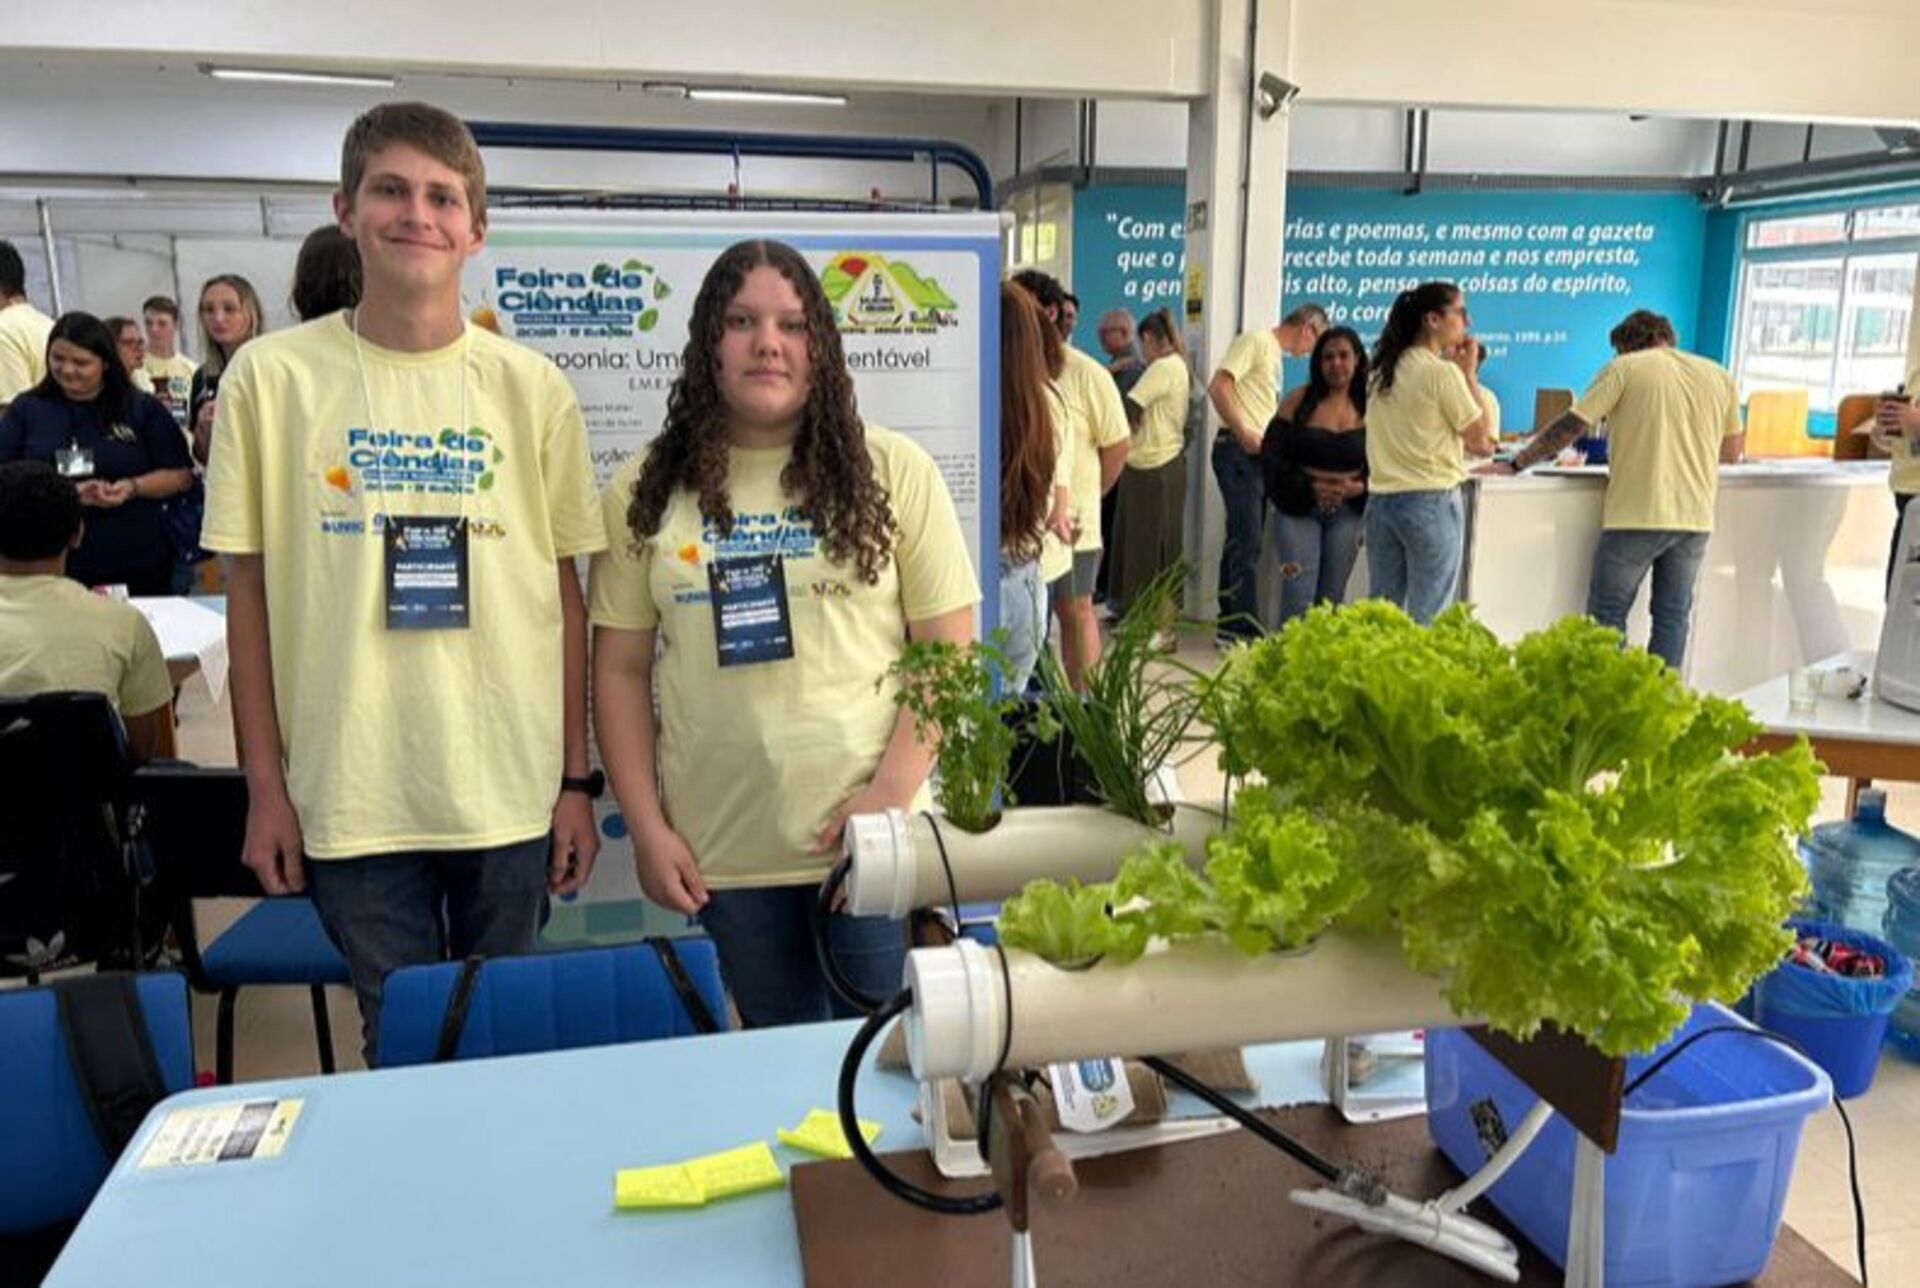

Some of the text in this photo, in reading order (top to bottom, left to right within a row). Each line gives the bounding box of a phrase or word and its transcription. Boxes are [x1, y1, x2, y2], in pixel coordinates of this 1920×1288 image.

[1285, 218, 1326, 240] rias
[1329, 224, 1343, 240] e
[1343, 223, 1431, 246] poemas,
[1436, 224, 1449, 240] e
[1452, 224, 1523, 241] mesmo
[1527, 224, 1569, 241] com
[1571, 225, 1586, 241] a
[1588, 222, 1655, 246] gazeta
[1117, 251, 1158, 273] que
[1161, 252, 1176, 268] o
[1284, 246, 1352, 267] recebe
[1355, 246, 1403, 267] toda
[1406, 249, 1486, 267] semana
[1489, 250, 1502, 266] e
[1505, 250, 1540, 266] nos
[1544, 246, 1640, 271] empresta,
[495, 267, 643, 288] Feira de
[1124, 280, 1138, 296] a
[1142, 279, 1182, 302] gen
[1284, 272, 1302, 295] is
[1306, 273, 1353, 295] alto,
[1457, 272, 1519, 293] coisas
[1523, 272, 1549, 293] do
[498, 289, 645, 312] Ciências
[545, 348, 630, 370] ponia:
[847, 347, 930, 368] entável
[348, 428, 486, 452] Feira de
[349, 449, 486, 473] Ciências
